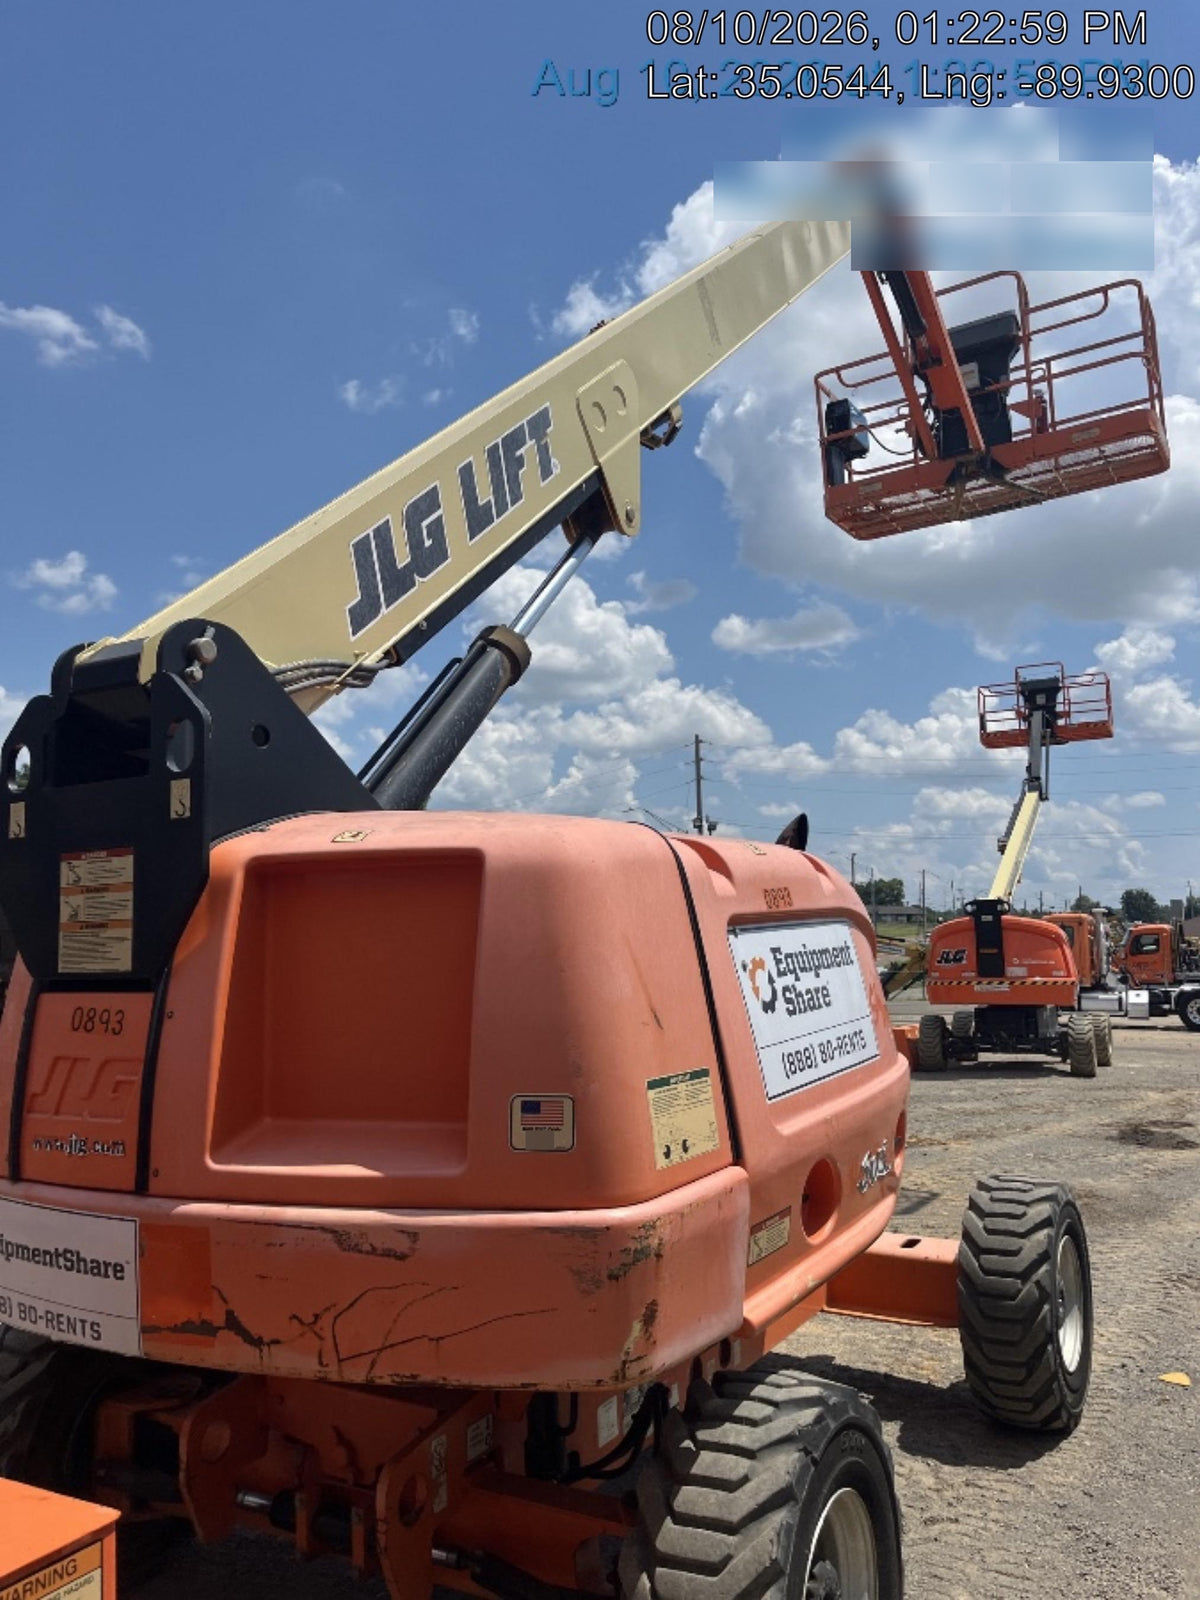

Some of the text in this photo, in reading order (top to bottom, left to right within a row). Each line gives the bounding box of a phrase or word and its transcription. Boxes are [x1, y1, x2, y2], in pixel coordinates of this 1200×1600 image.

[346, 401, 555, 642] JLG LIFT
[770, 940, 853, 982] Equipment
[71, 1006, 125, 1036] 0893
[782, 983, 831, 1018] Share
[781, 1029, 867, 1080] (888) 80-RENTS
[26, 1055, 145, 1124] JLG
[17, 1302, 102, 1341] 80-RENTS
